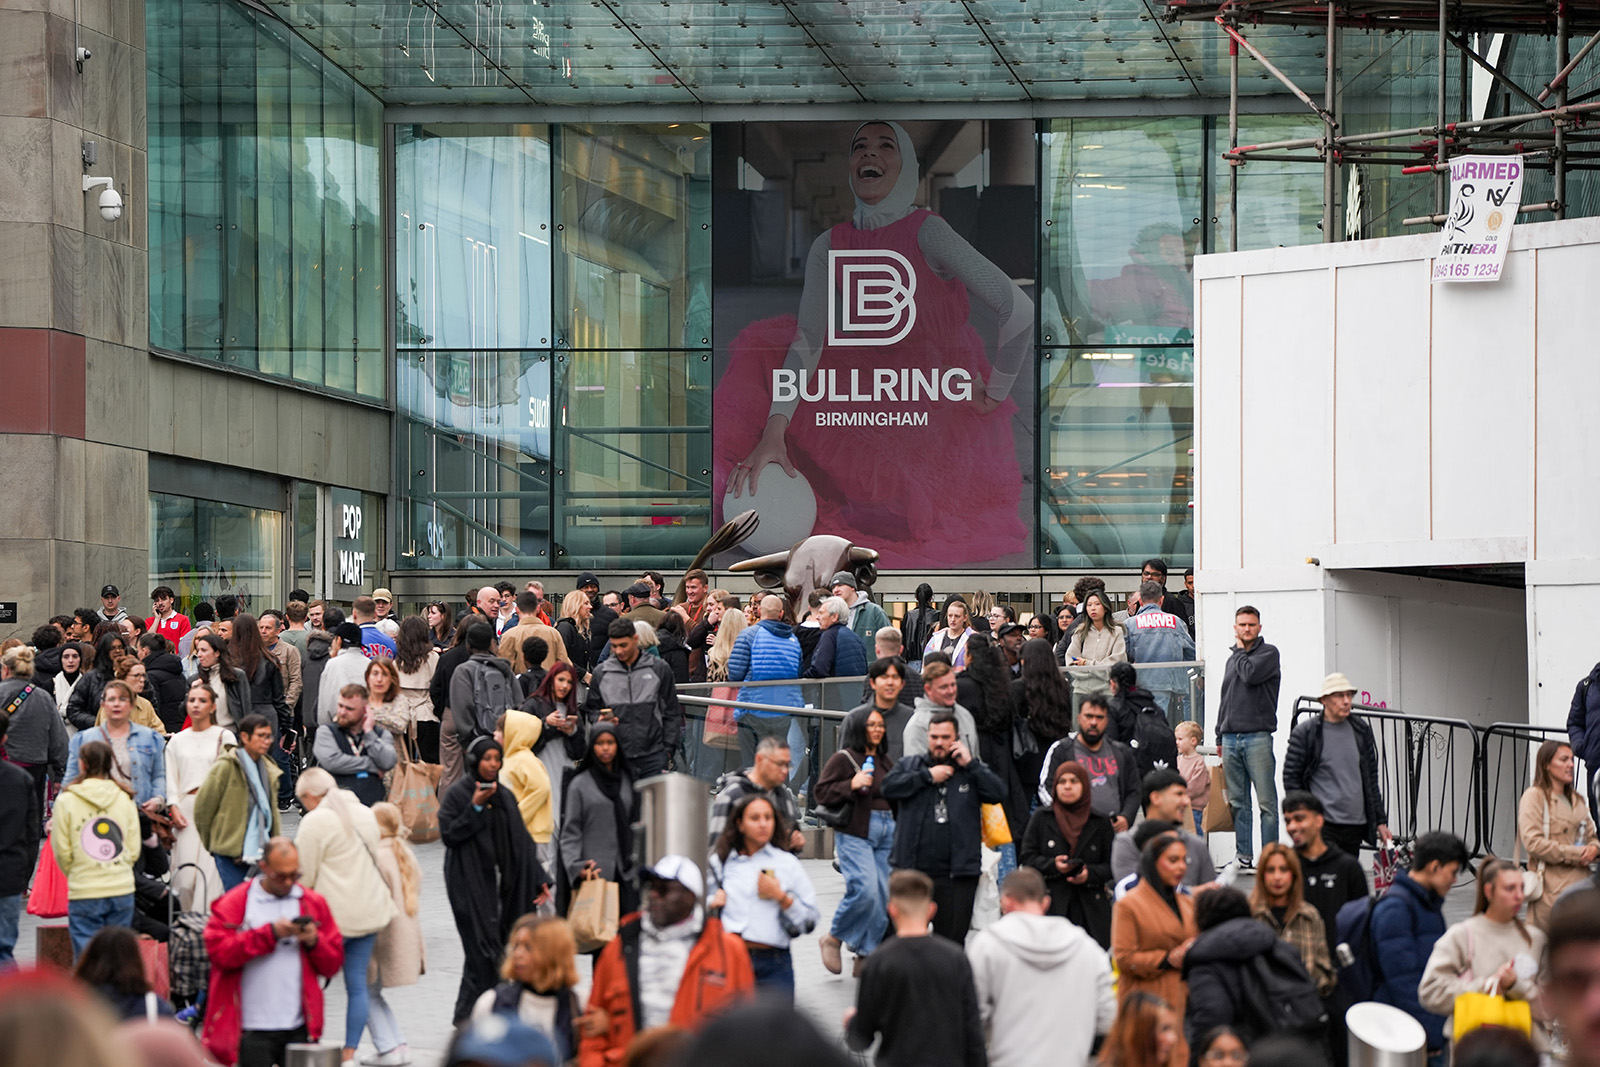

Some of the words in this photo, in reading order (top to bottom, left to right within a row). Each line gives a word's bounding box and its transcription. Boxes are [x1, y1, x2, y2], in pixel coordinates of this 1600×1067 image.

[1451, 162, 1520, 182] ALARMED
[1441, 243, 1498, 256] PANTHERA
[1449, 263, 1470, 277] 165
[1473, 263, 1500, 277] 1234
[772, 367, 972, 402] BULLRING
[815, 412, 928, 426] BIRMINGHAM
[342, 504, 361, 539] POP
[340, 550, 365, 586] MART
[1137, 614, 1176, 629] MARVEL
